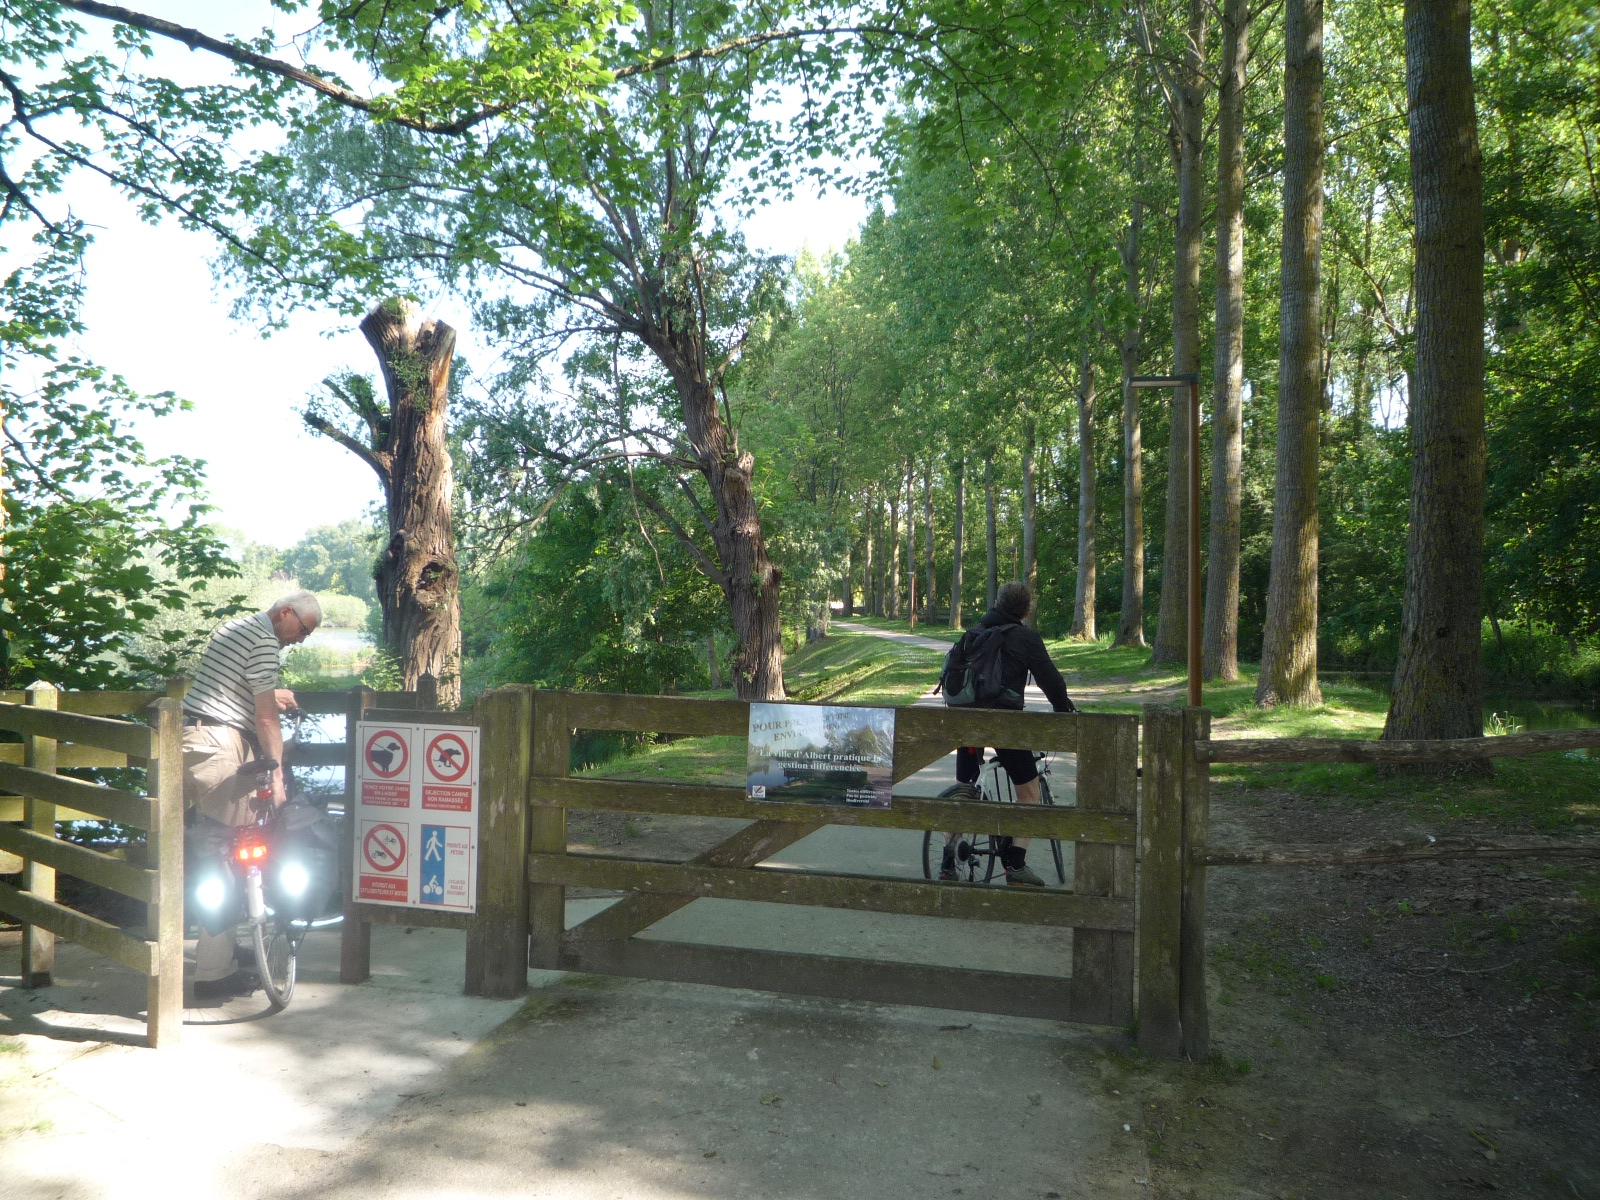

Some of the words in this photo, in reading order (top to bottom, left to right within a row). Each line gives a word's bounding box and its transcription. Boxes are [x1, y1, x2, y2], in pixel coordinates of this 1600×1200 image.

[752, 720, 782, 732] POUR
[834, 754, 871, 763] pratique
[810, 762, 861, 772] différenciée
